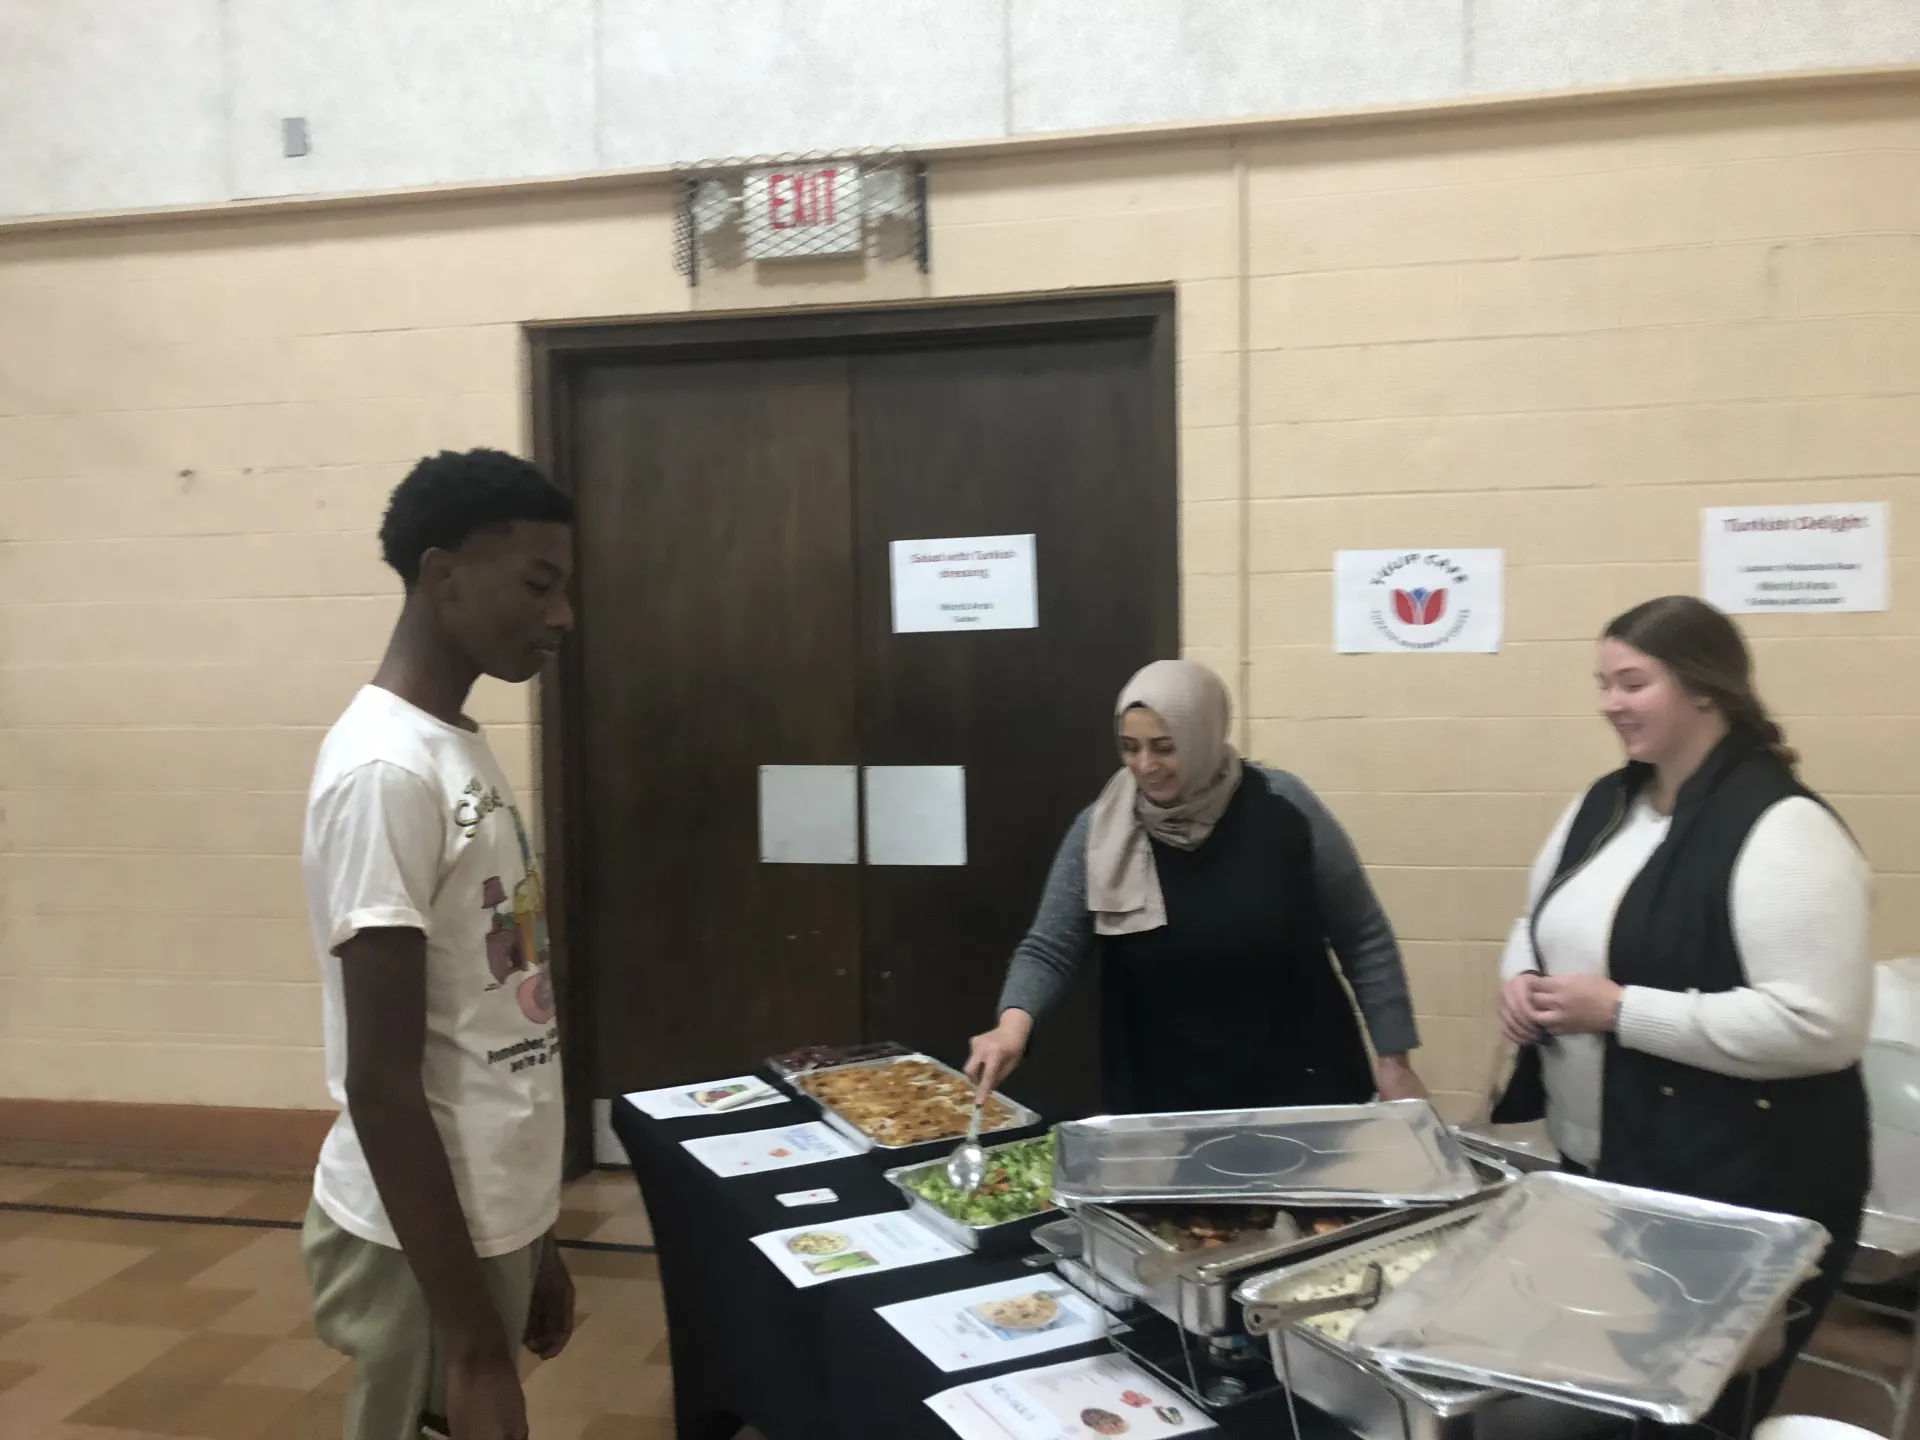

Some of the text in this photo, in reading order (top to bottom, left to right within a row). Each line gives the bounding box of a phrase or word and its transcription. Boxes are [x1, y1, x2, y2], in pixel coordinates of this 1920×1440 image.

[769, 170, 836, 230] EXIT
[1722, 512, 1869, 533] Turkish Delight
[910, 552, 945, 564] Salad
[971, 549, 1017, 561] Turkish
